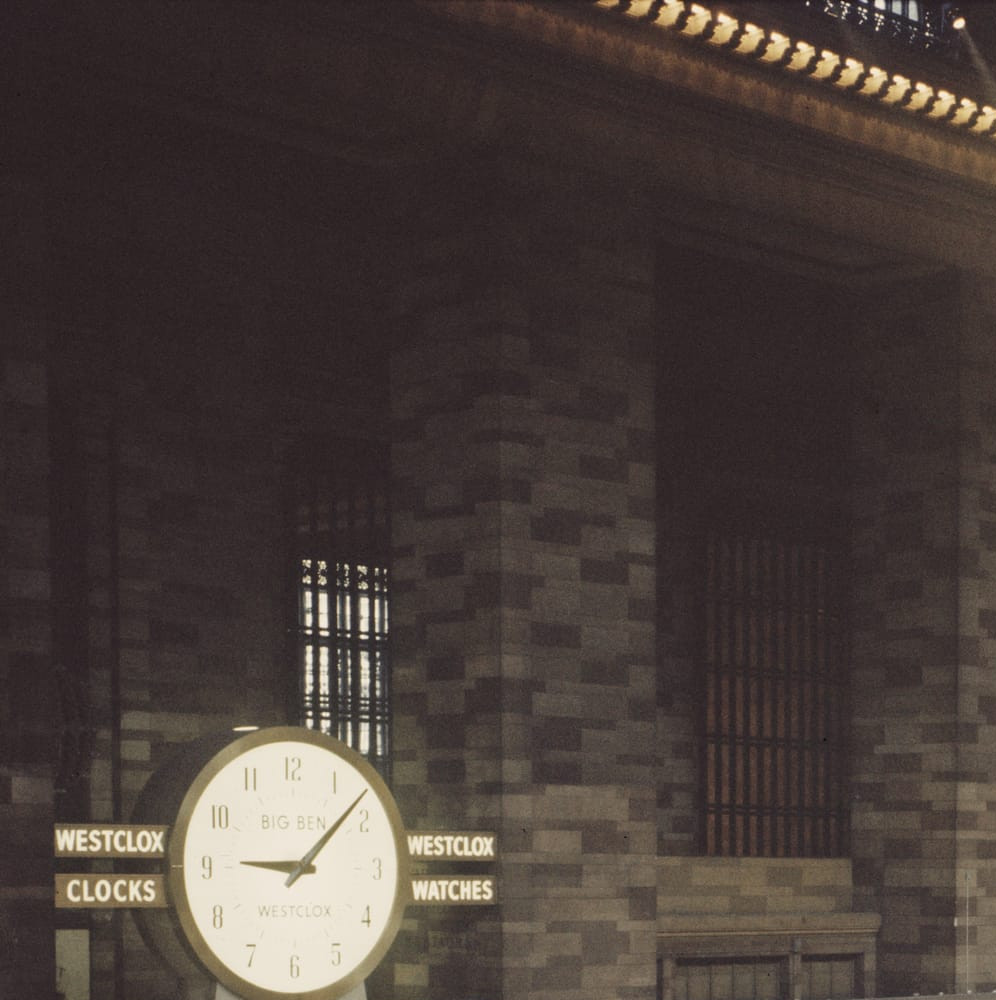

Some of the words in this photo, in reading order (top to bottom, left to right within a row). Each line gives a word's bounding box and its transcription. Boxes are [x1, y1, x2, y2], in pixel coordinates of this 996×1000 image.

[245, 767, 257, 791] 11
[285, 757, 301, 781] 12
[332, 770, 337, 795] 1
[212, 804, 229, 829] 10
[261, 815, 290, 830] BIG
[297, 815, 327, 831] BEN
[359, 809, 370, 833] 2
[55, 829, 165, 853] WESTCLOX
[407, 835, 494, 857] WESTCLOX
[202, 855, 213, 880] 9
[372, 857, 382, 881] 3
[66, 879, 156, 903] CLOCKS
[412, 879, 494, 901] WATCHES
[212, 904, 223, 929] 8
[258, 905, 332, 918] WESTCLOX
[361, 905, 371, 928] 4
[246, 943, 257, 968] 7
[331, 942, 341, 966] 5
[290, 954, 300, 979] 6
